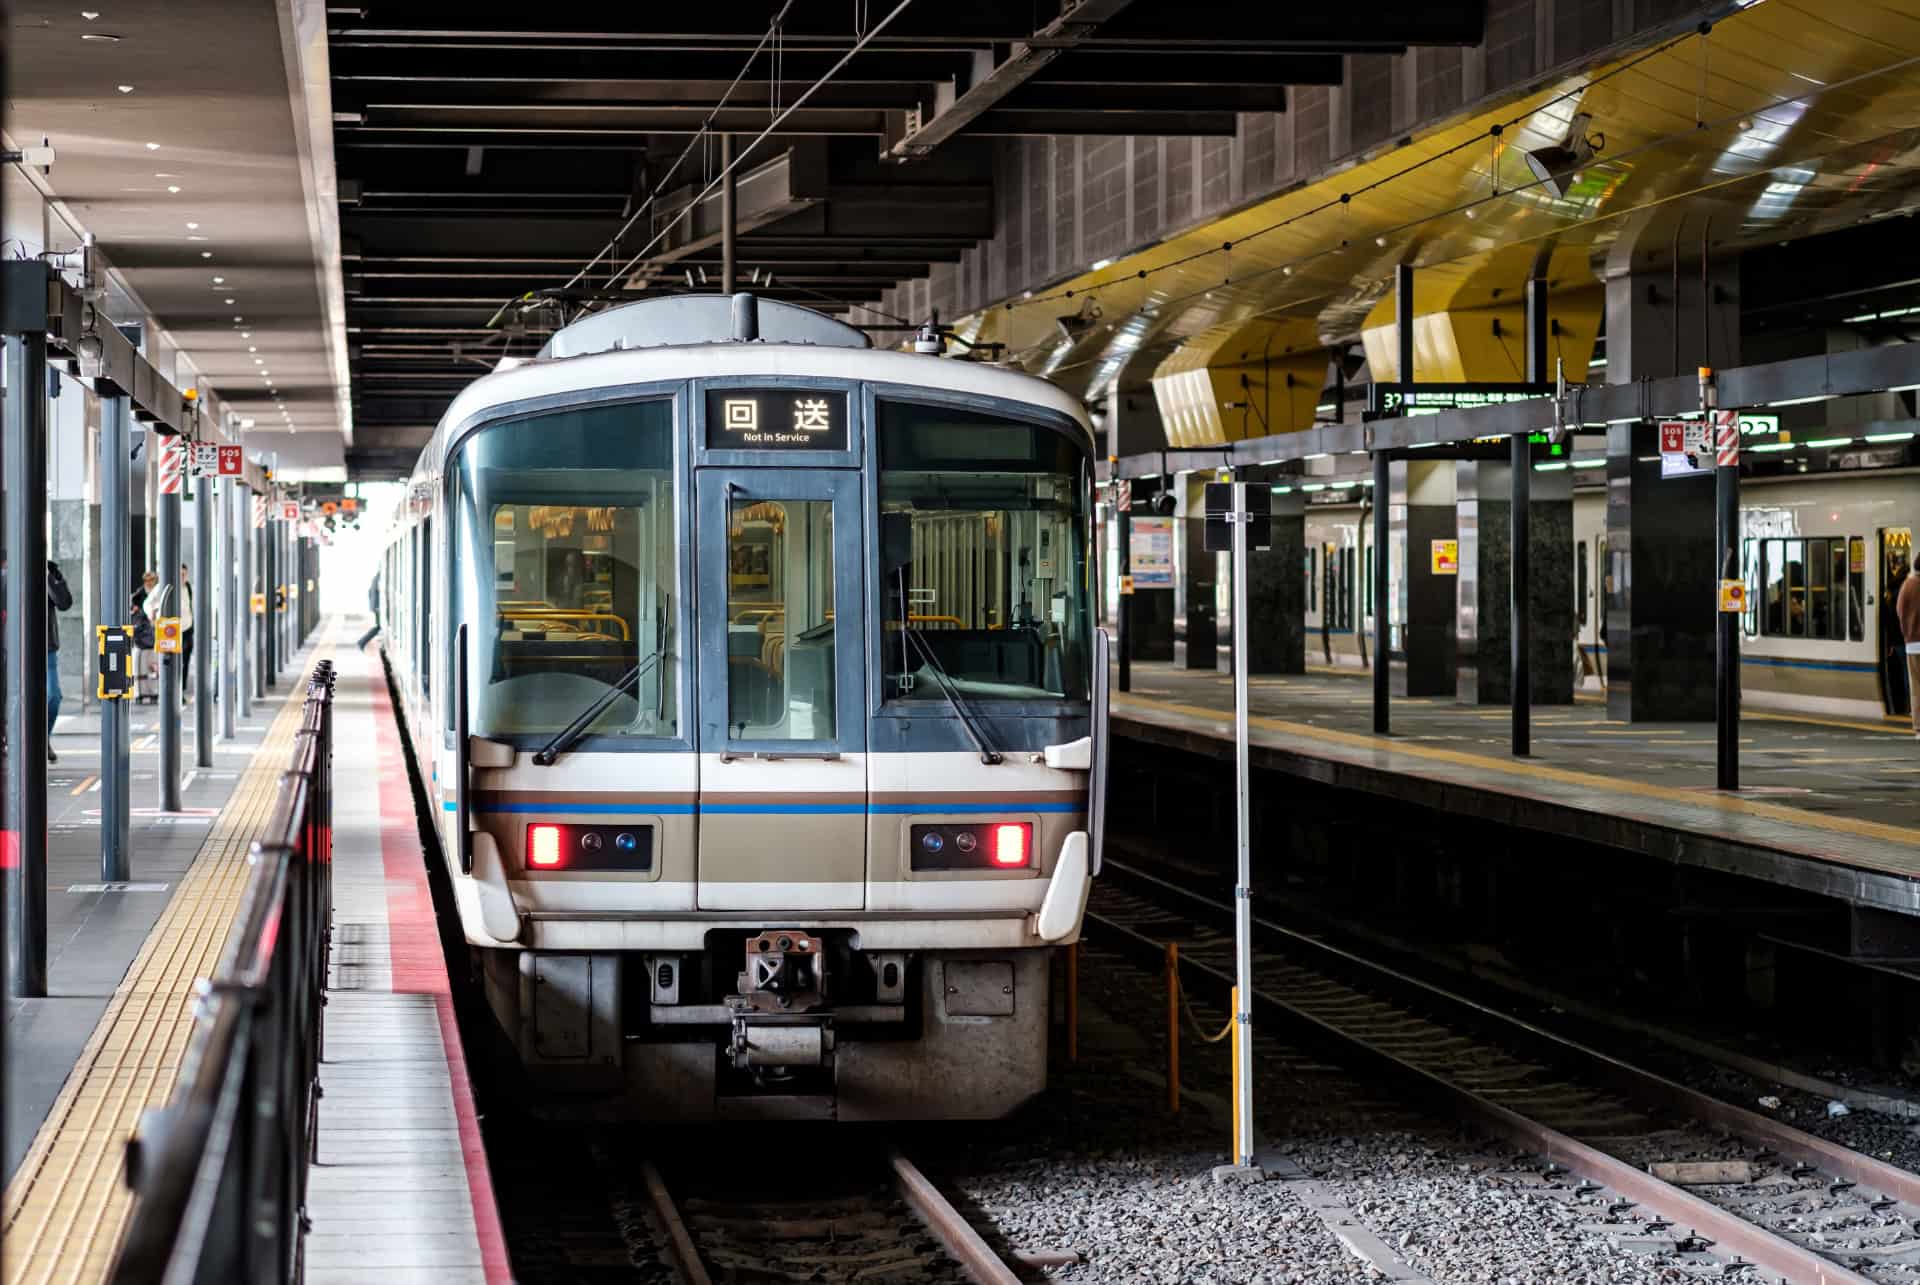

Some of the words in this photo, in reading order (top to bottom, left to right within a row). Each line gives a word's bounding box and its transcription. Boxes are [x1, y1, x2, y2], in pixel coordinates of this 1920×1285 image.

[725, 399, 830, 431] 回送
[1664, 427, 1681, 435] SOS
[743, 432, 762, 442] Not
[763, 432, 774, 442] in
[775, 432, 810, 442] Service
[220, 449, 240, 457] SOS
